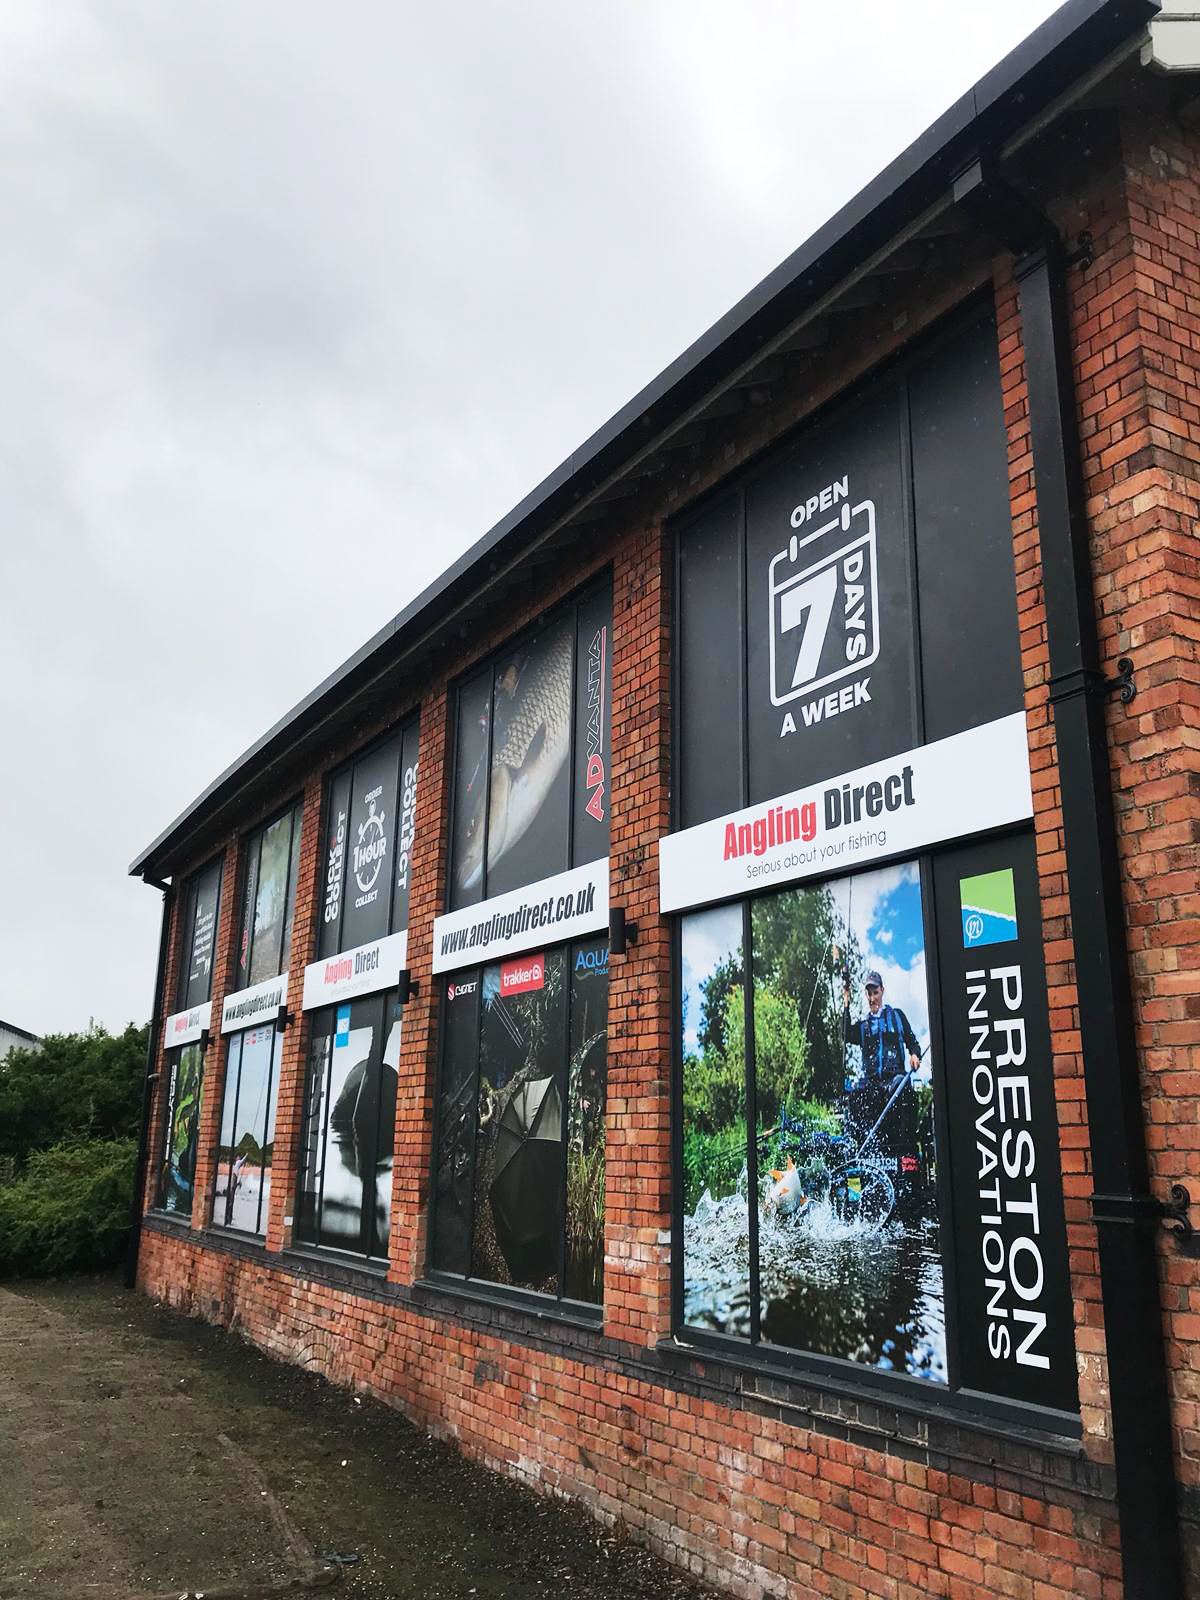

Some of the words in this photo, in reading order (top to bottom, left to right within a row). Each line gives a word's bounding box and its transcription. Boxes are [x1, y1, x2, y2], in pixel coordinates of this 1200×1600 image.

[790, 475, 850, 529] OPEN
[780, 565, 838, 689] 7
[843, 550, 867, 663] DAYS
[585, 626, 606, 823] ADVANTA
[780, 712, 797, 738] A
[801, 677, 873, 728] WEEK
[398, 767, 413, 890] COLLECT
[723, 799, 817, 862] Angling
[823, 766, 916, 831] Direct
[324, 848, 336, 923] CLICK
[331, 811, 346, 920] COLLECT
[746, 861, 782, 879] Serious
[783, 849, 818, 869] about
[819, 844, 846, 865] your
[847, 829, 887, 854] fishing
[355, 889, 379, 909] COLLECT
[440, 882, 596, 957] www.anglingdirect.co.uk
[324, 957, 353, 985] Angling
[354, 946, 380, 975] Direct
[503, 967, 533, 988] trakker
[964, 968, 1011, 1361] INNOVATIONS
[988, 964, 1051, 1371] PRESTON
